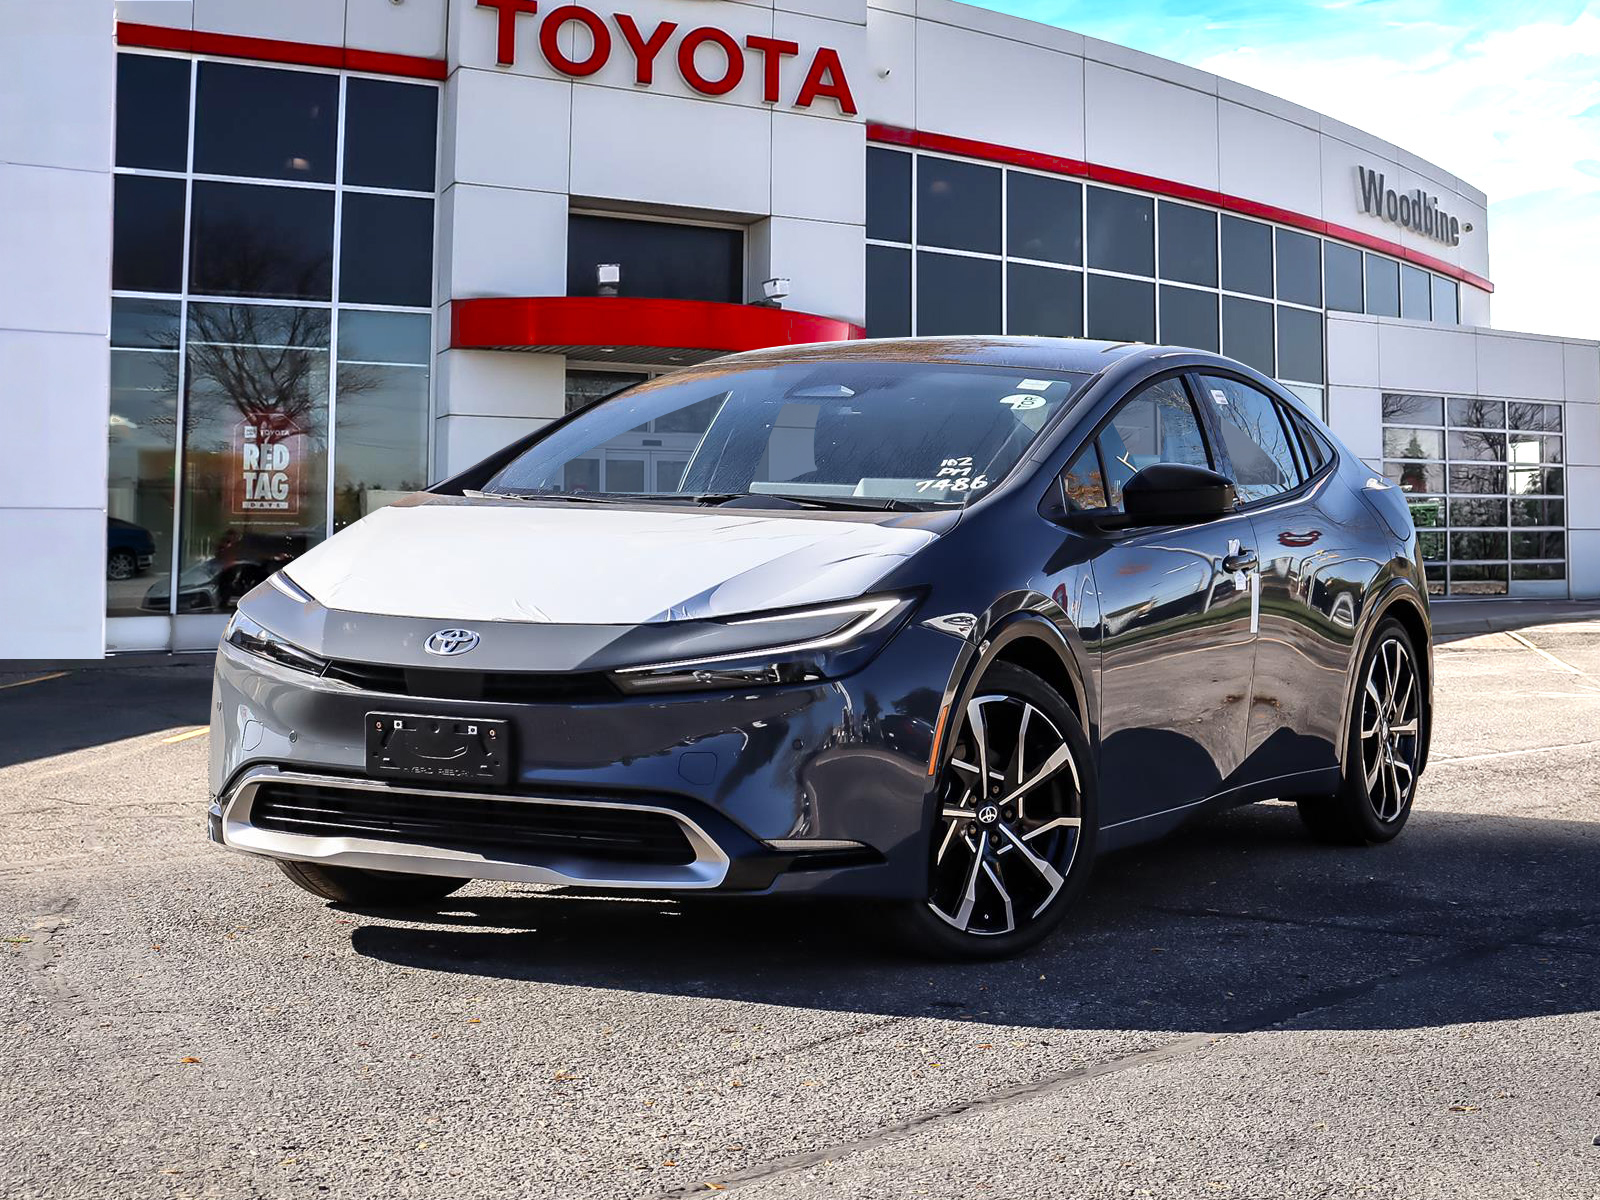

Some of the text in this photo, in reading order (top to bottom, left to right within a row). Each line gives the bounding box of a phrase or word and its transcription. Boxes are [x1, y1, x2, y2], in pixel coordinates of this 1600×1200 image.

[476, 0, 858, 117] TOYOTA
[1356, 165, 1460, 247] Woodbine
[260, 429, 290, 437] TOYOTA
[243, 443, 290, 471] RED
[243, 472, 289, 500] TAG
[915, 474, 988, 493] 7486
